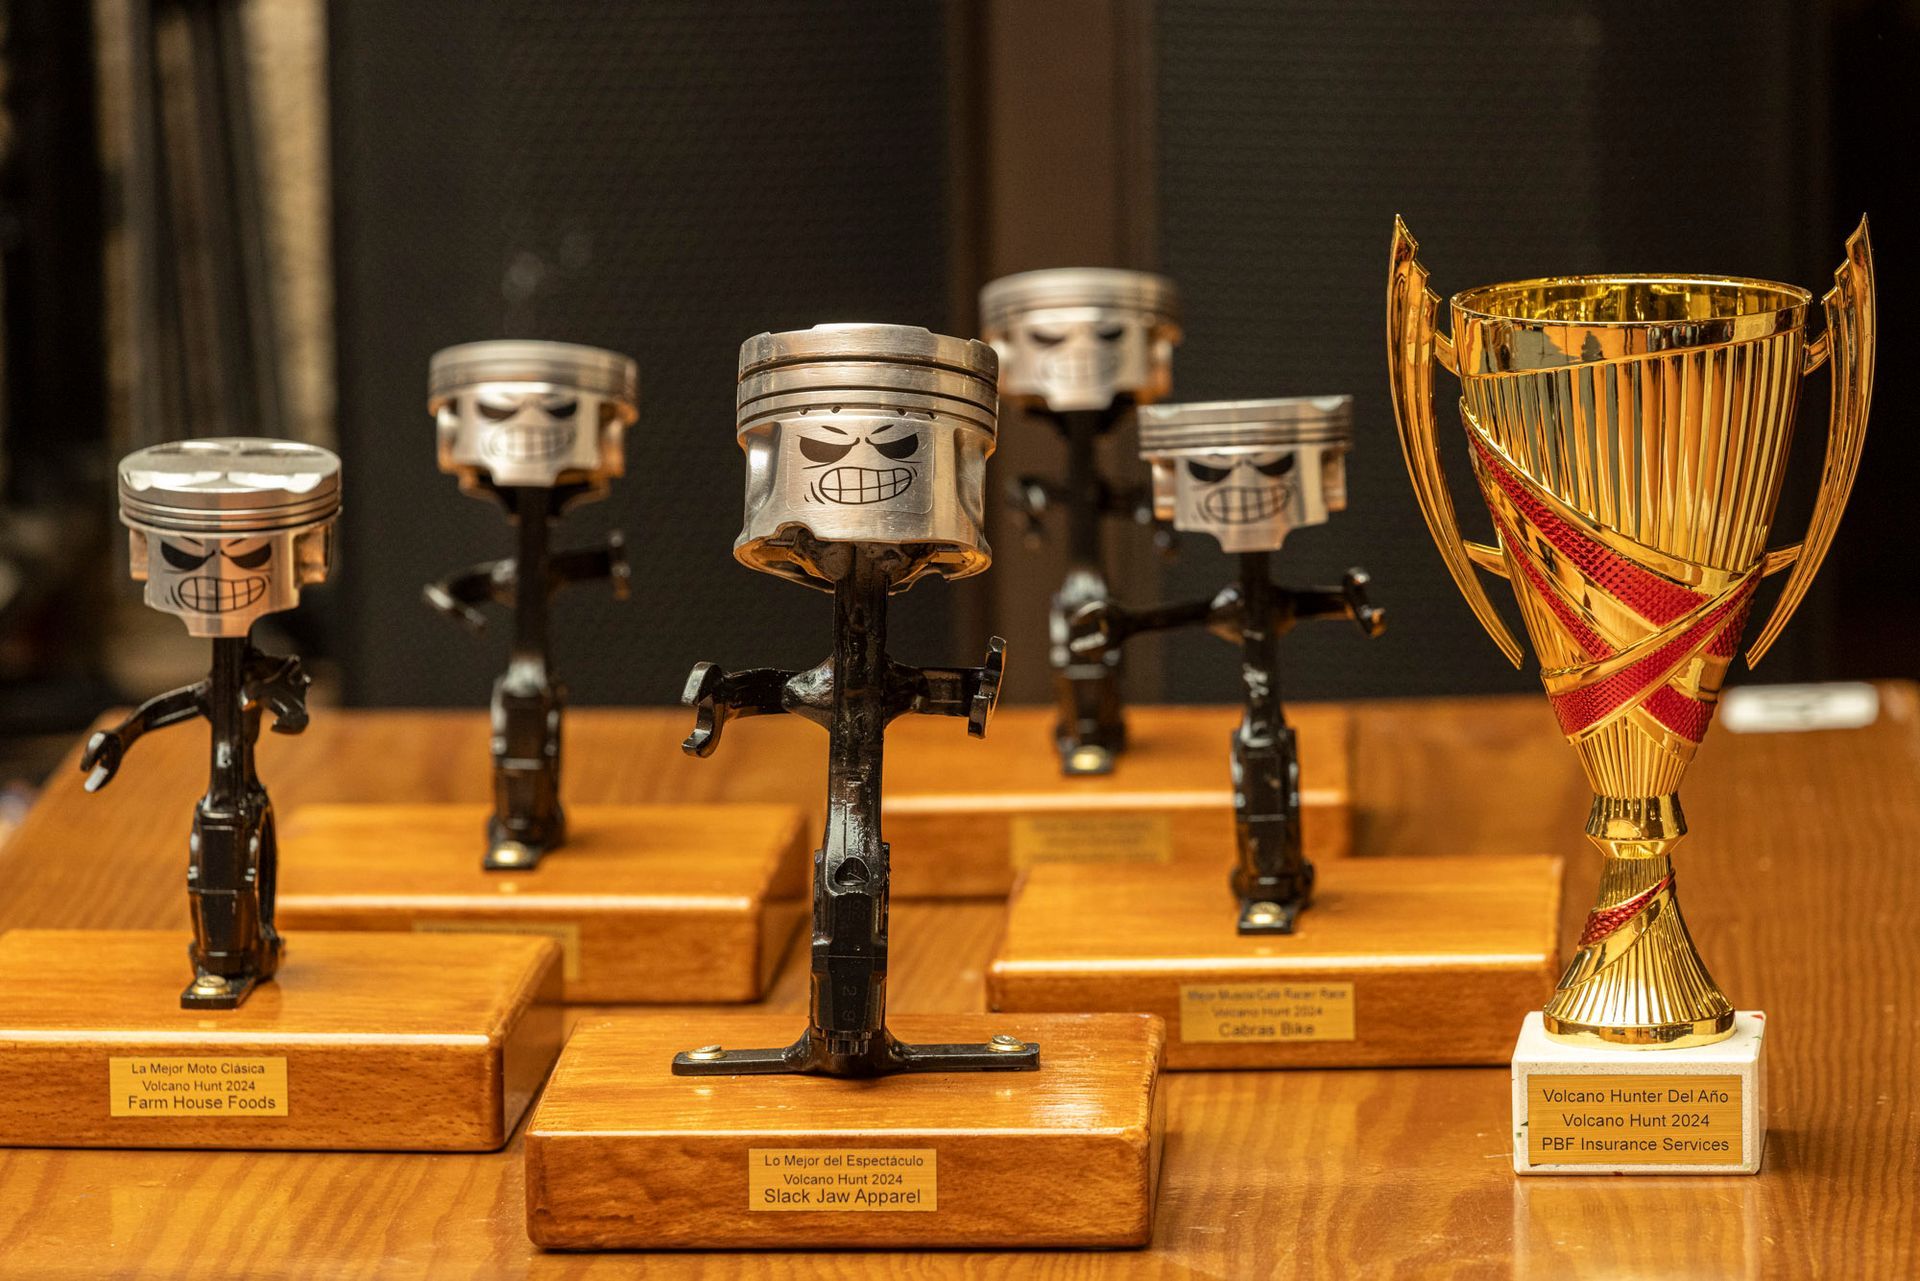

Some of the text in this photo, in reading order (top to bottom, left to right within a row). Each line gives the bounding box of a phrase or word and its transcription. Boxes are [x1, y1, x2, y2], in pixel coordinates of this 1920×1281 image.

[1218, 1021, 1316, 1037] Cabras Bike
[131, 1062, 266, 1077] La Mejor Moto Clásica
[142, 1080, 256, 1092] Volcano Hunt 2024
[128, 1095, 277, 1110] Farm House Foods
[1542, 1088, 1730, 1104] Volcano Hunter Del Año
[1562, 1113, 1711, 1128] Volcano Hunt 2024
[1542, 1137, 1730, 1152] PBF Insurance Services
[764, 1154, 925, 1169] Lo Mejor del Espectáculo
[783, 1173, 904, 1186] Volcano Hunt 2024
[764, 1187, 922, 1207] Slack Jaw Apparel
